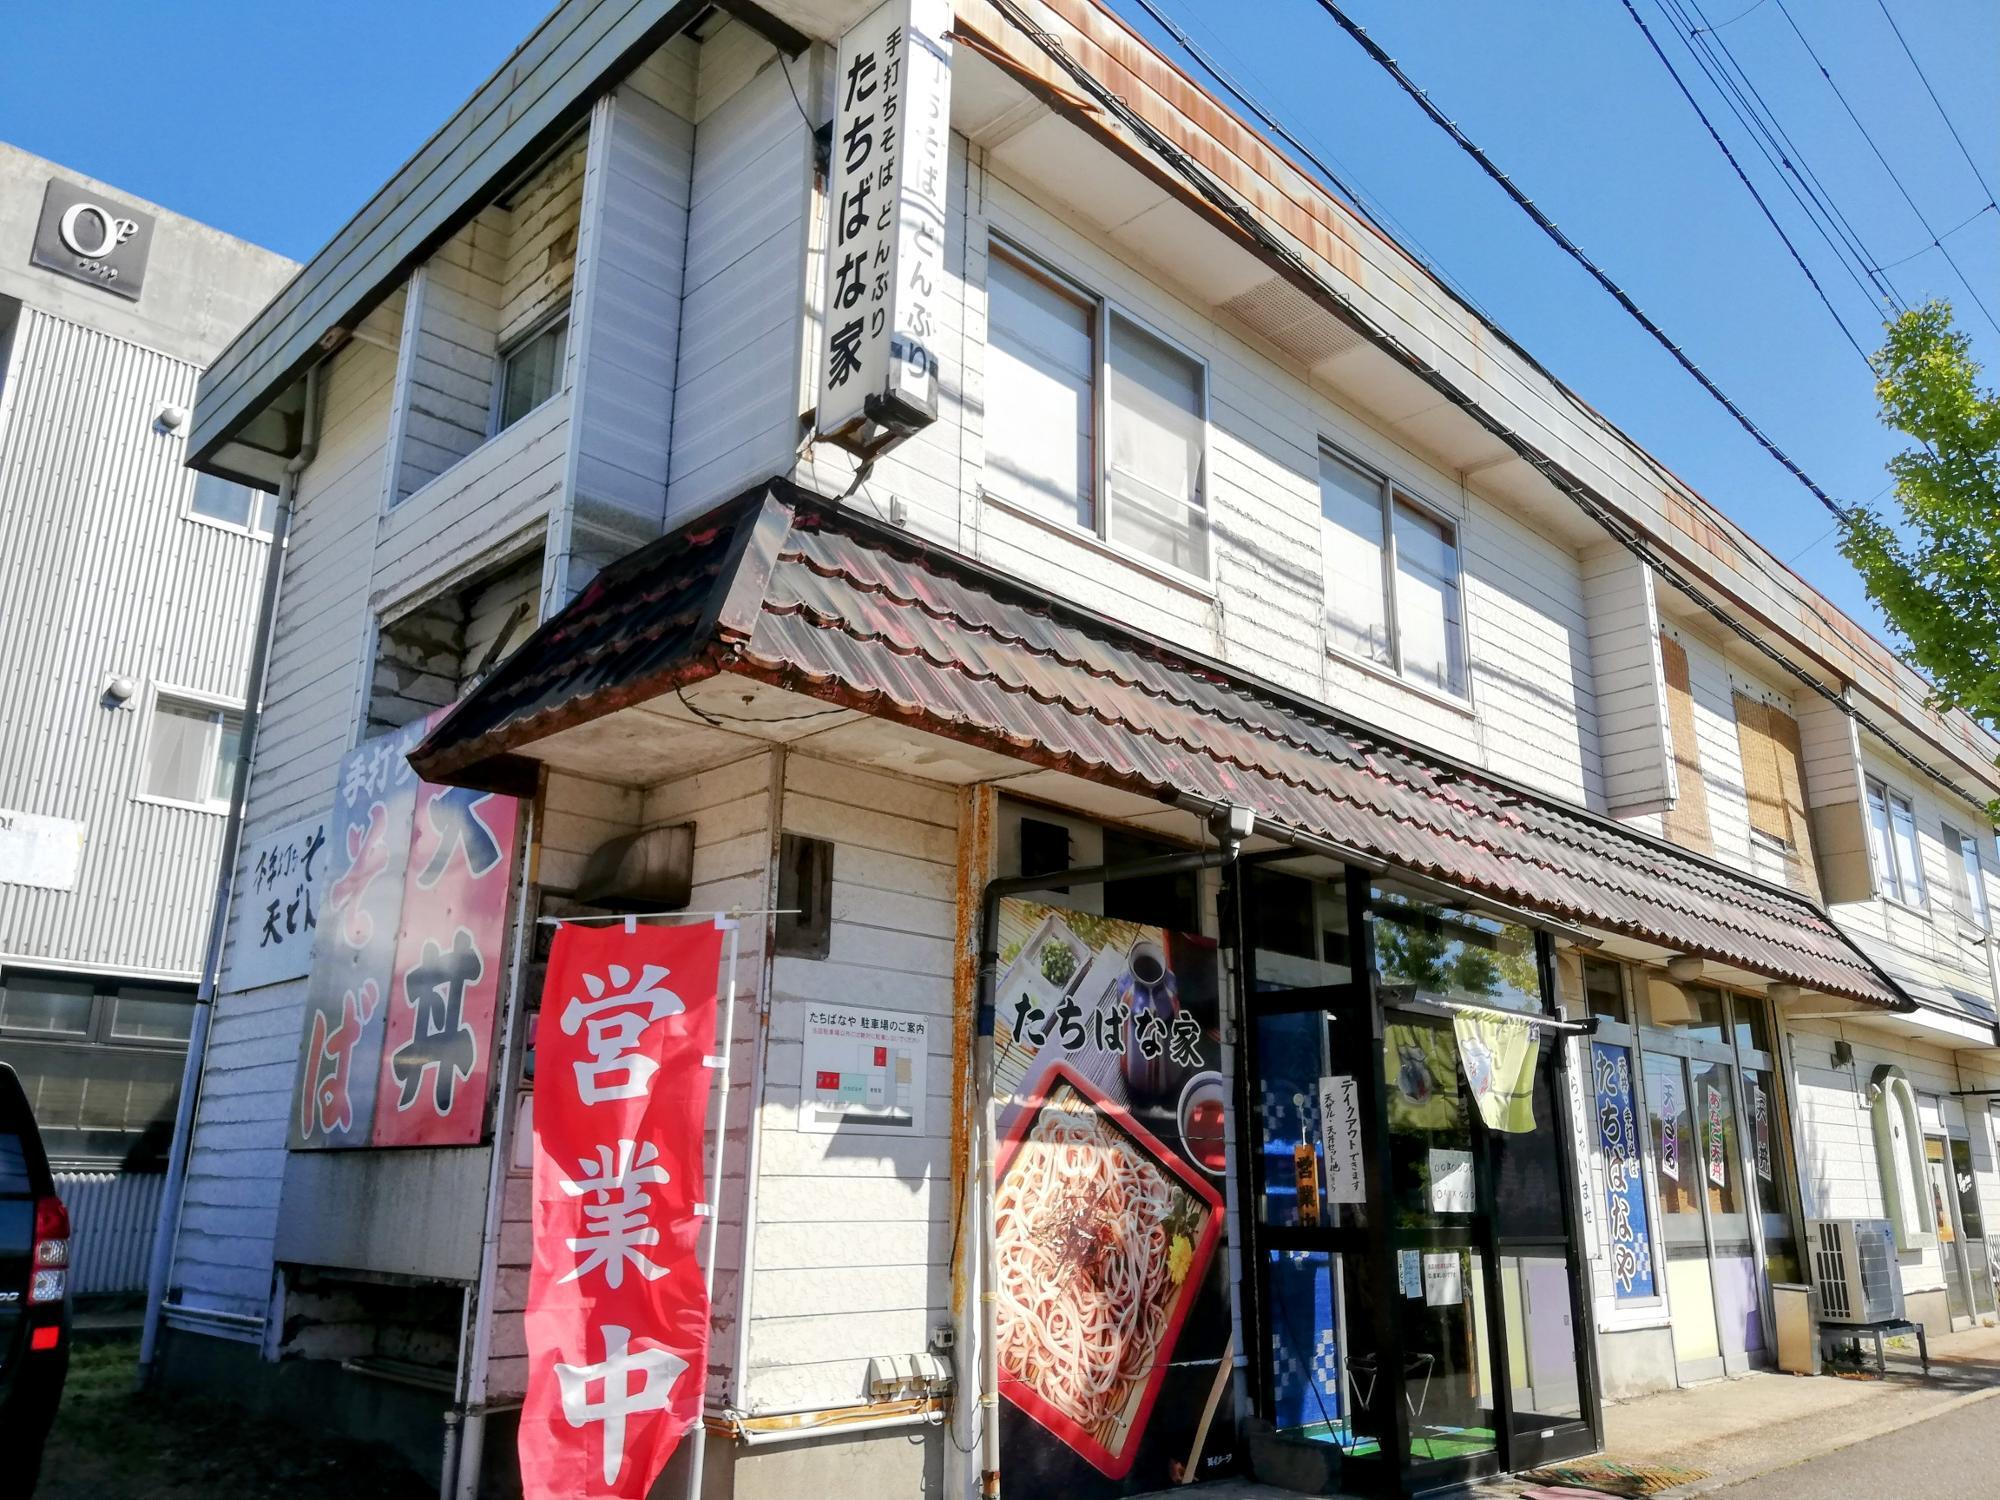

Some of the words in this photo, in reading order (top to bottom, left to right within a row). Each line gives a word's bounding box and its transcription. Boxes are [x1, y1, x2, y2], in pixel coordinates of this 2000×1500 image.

[878, 26, 902, 190] 手打ちそば
[828, 52, 877, 391] たちばな家
[870, 202, 893, 341] どんぶり
[301, 800, 389, 1140] そば
[809, 1012, 857, 1028] たちばなや
[860, 1016, 925, 1036] 駐車場のご案内
[1011, 992, 1204, 1067] たちばな家
[1341, 1080, 1361, 1191] テイクアウトできます
[1594, 1050, 1636, 1293] たちばなや
[554, 964, 690, 1487] 営業中
